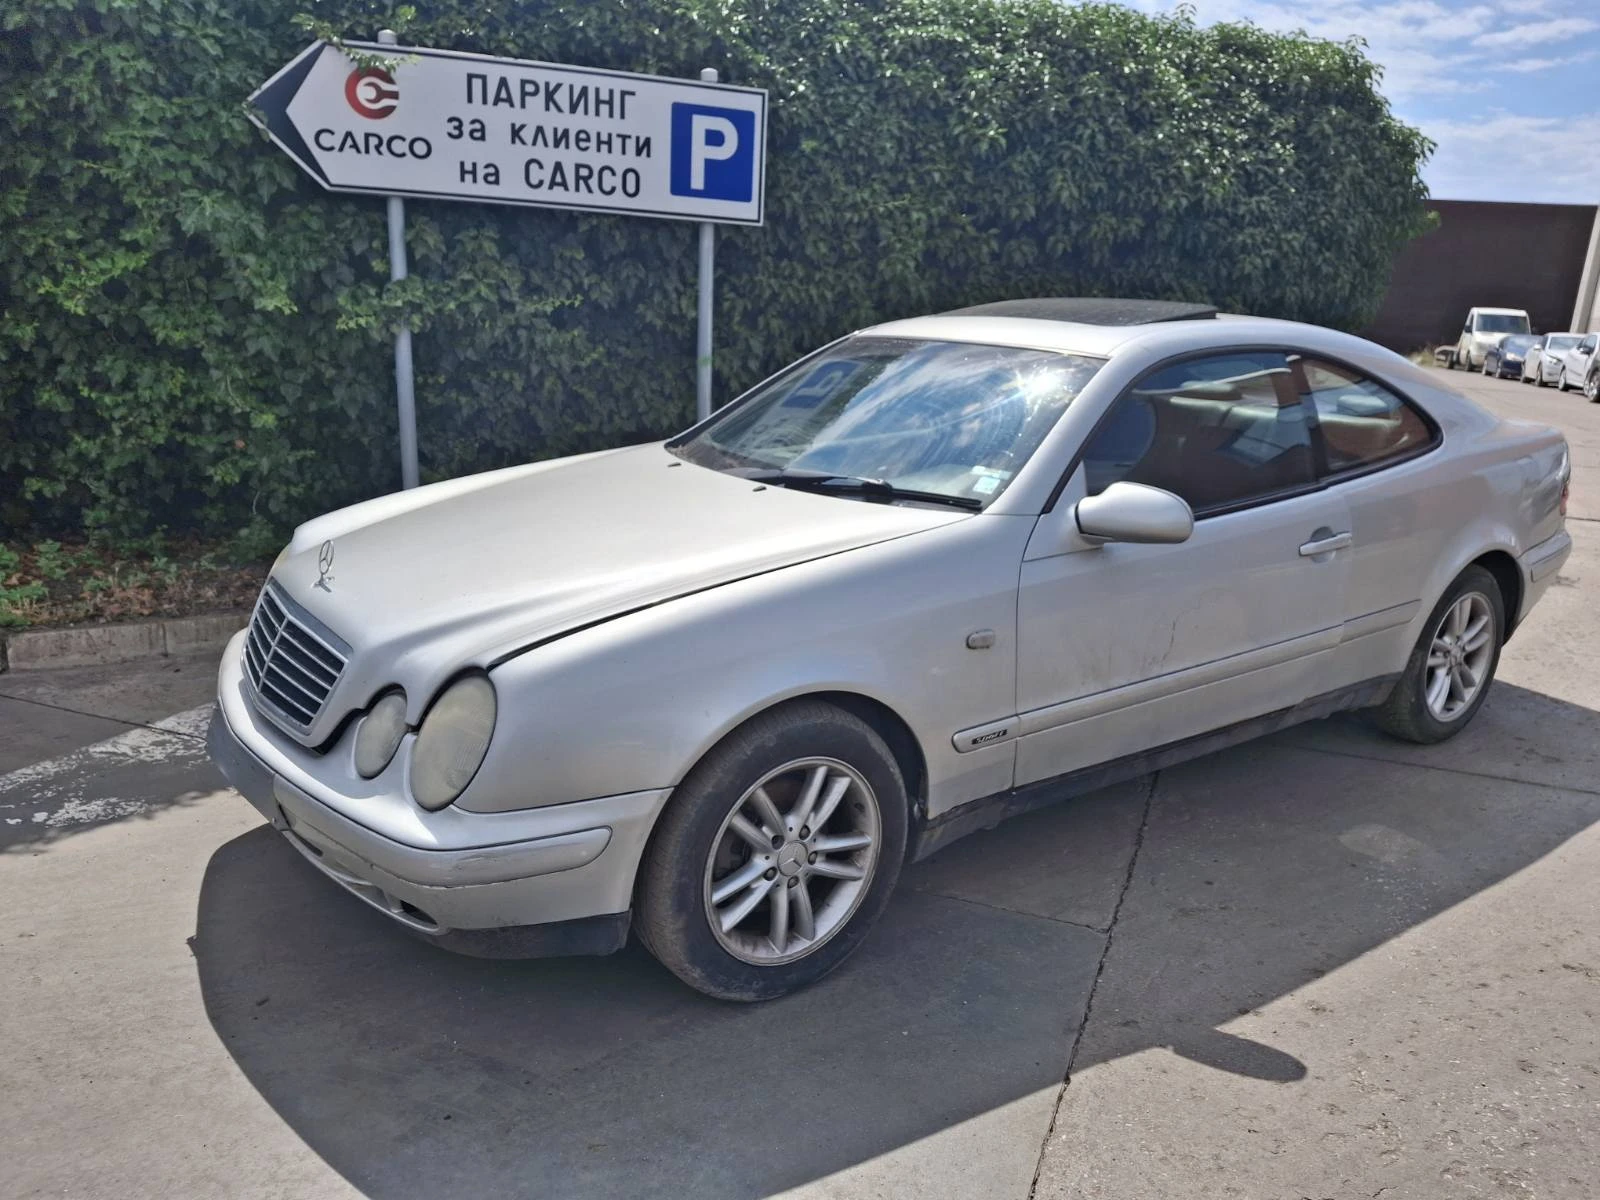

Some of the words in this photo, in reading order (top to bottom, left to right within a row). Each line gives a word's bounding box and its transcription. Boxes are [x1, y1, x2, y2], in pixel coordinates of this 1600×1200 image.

[466, 72, 636, 120] ПАРКИНГ
[314, 128, 432, 160] CARCO
[446, 116, 486, 142] за
[510, 122, 652, 158] клиенти
[690, 113, 739, 191] P
[459, 160, 500, 186] на
[524, 158, 641, 198] CARCO
